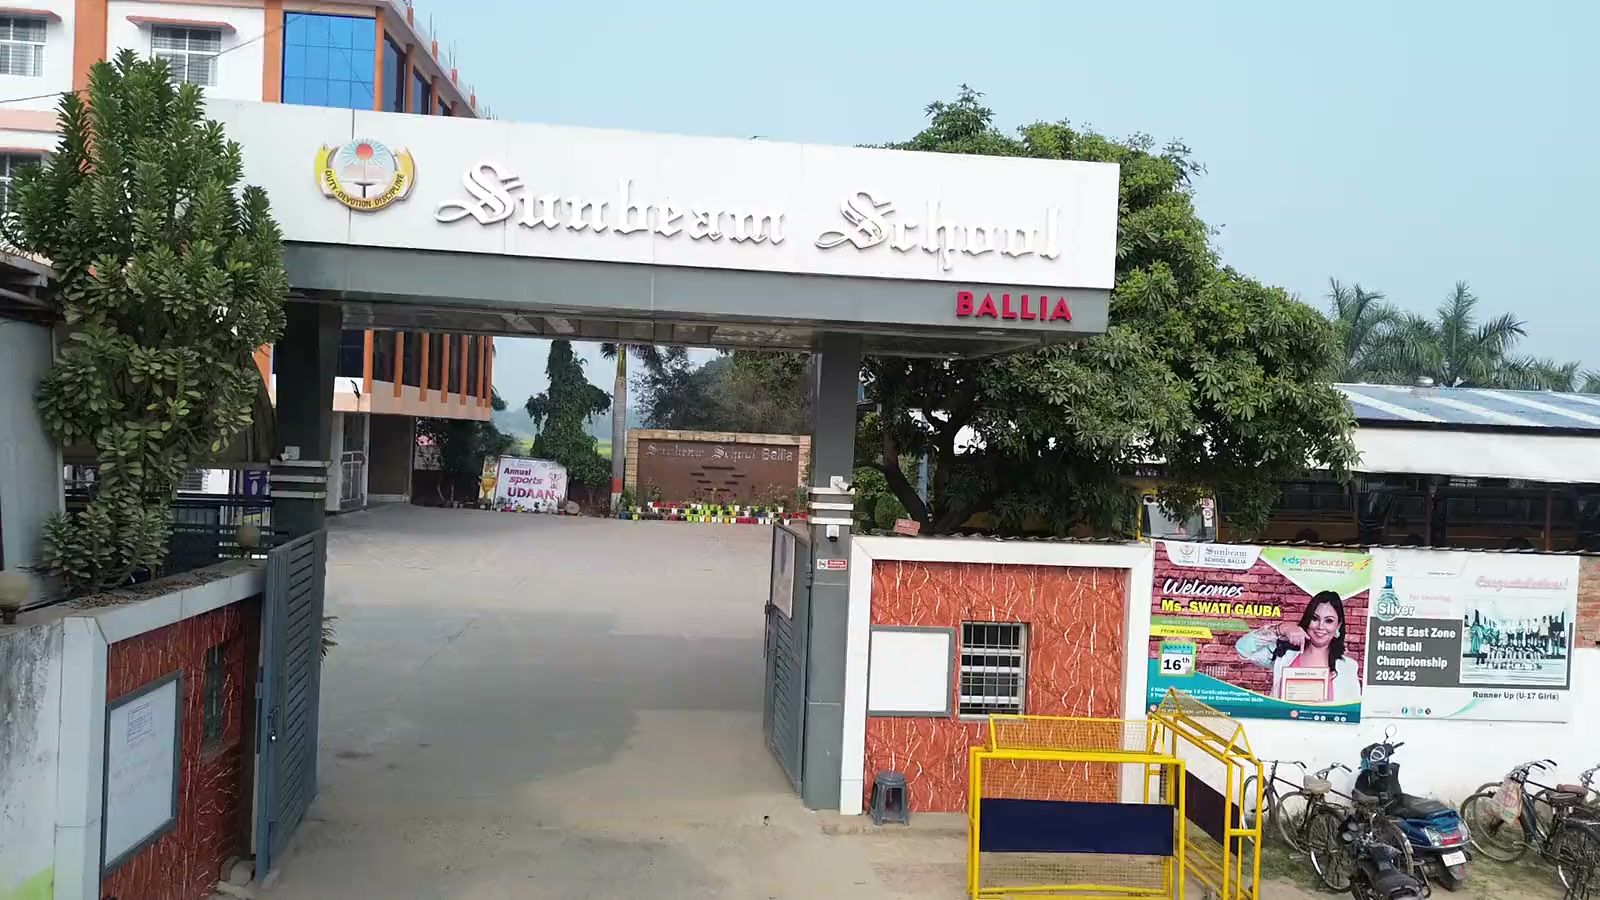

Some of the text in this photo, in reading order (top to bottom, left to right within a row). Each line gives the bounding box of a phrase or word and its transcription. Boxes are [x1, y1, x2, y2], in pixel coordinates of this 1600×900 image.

[325, 170, 404, 207] DUTY DEVOTION DISCIPLINE
[434, 160, 1061, 271] Sunbeam School
[956, 291, 1072, 321] BALLIA
[762, 448, 793, 462] Ballia
[504, 467, 531, 476] Annual
[509, 476, 544, 485] sports
[507, 487, 555, 500] UDAAN
[1205, 546, 1247, 557] Sunbeam
[1204, 556, 1226, 564] SCHOOL
[1228, 557, 1246, 565] BALLIA
[1162, 578, 1244, 598] Welcomes
[1161, 600, 1281, 618] Ms. SWATI GAUBA
[1378, 601, 1415, 615] Silver
[1378, 626, 1456, 639] CBSE East Zone
[1377, 641, 1422, 652] Handball
[1376, 656, 1448, 669] Championship
[1375, 671, 1417, 681] 2024-25
[1472, 691, 1559, 701] Runner Up (U-17 Girls)
